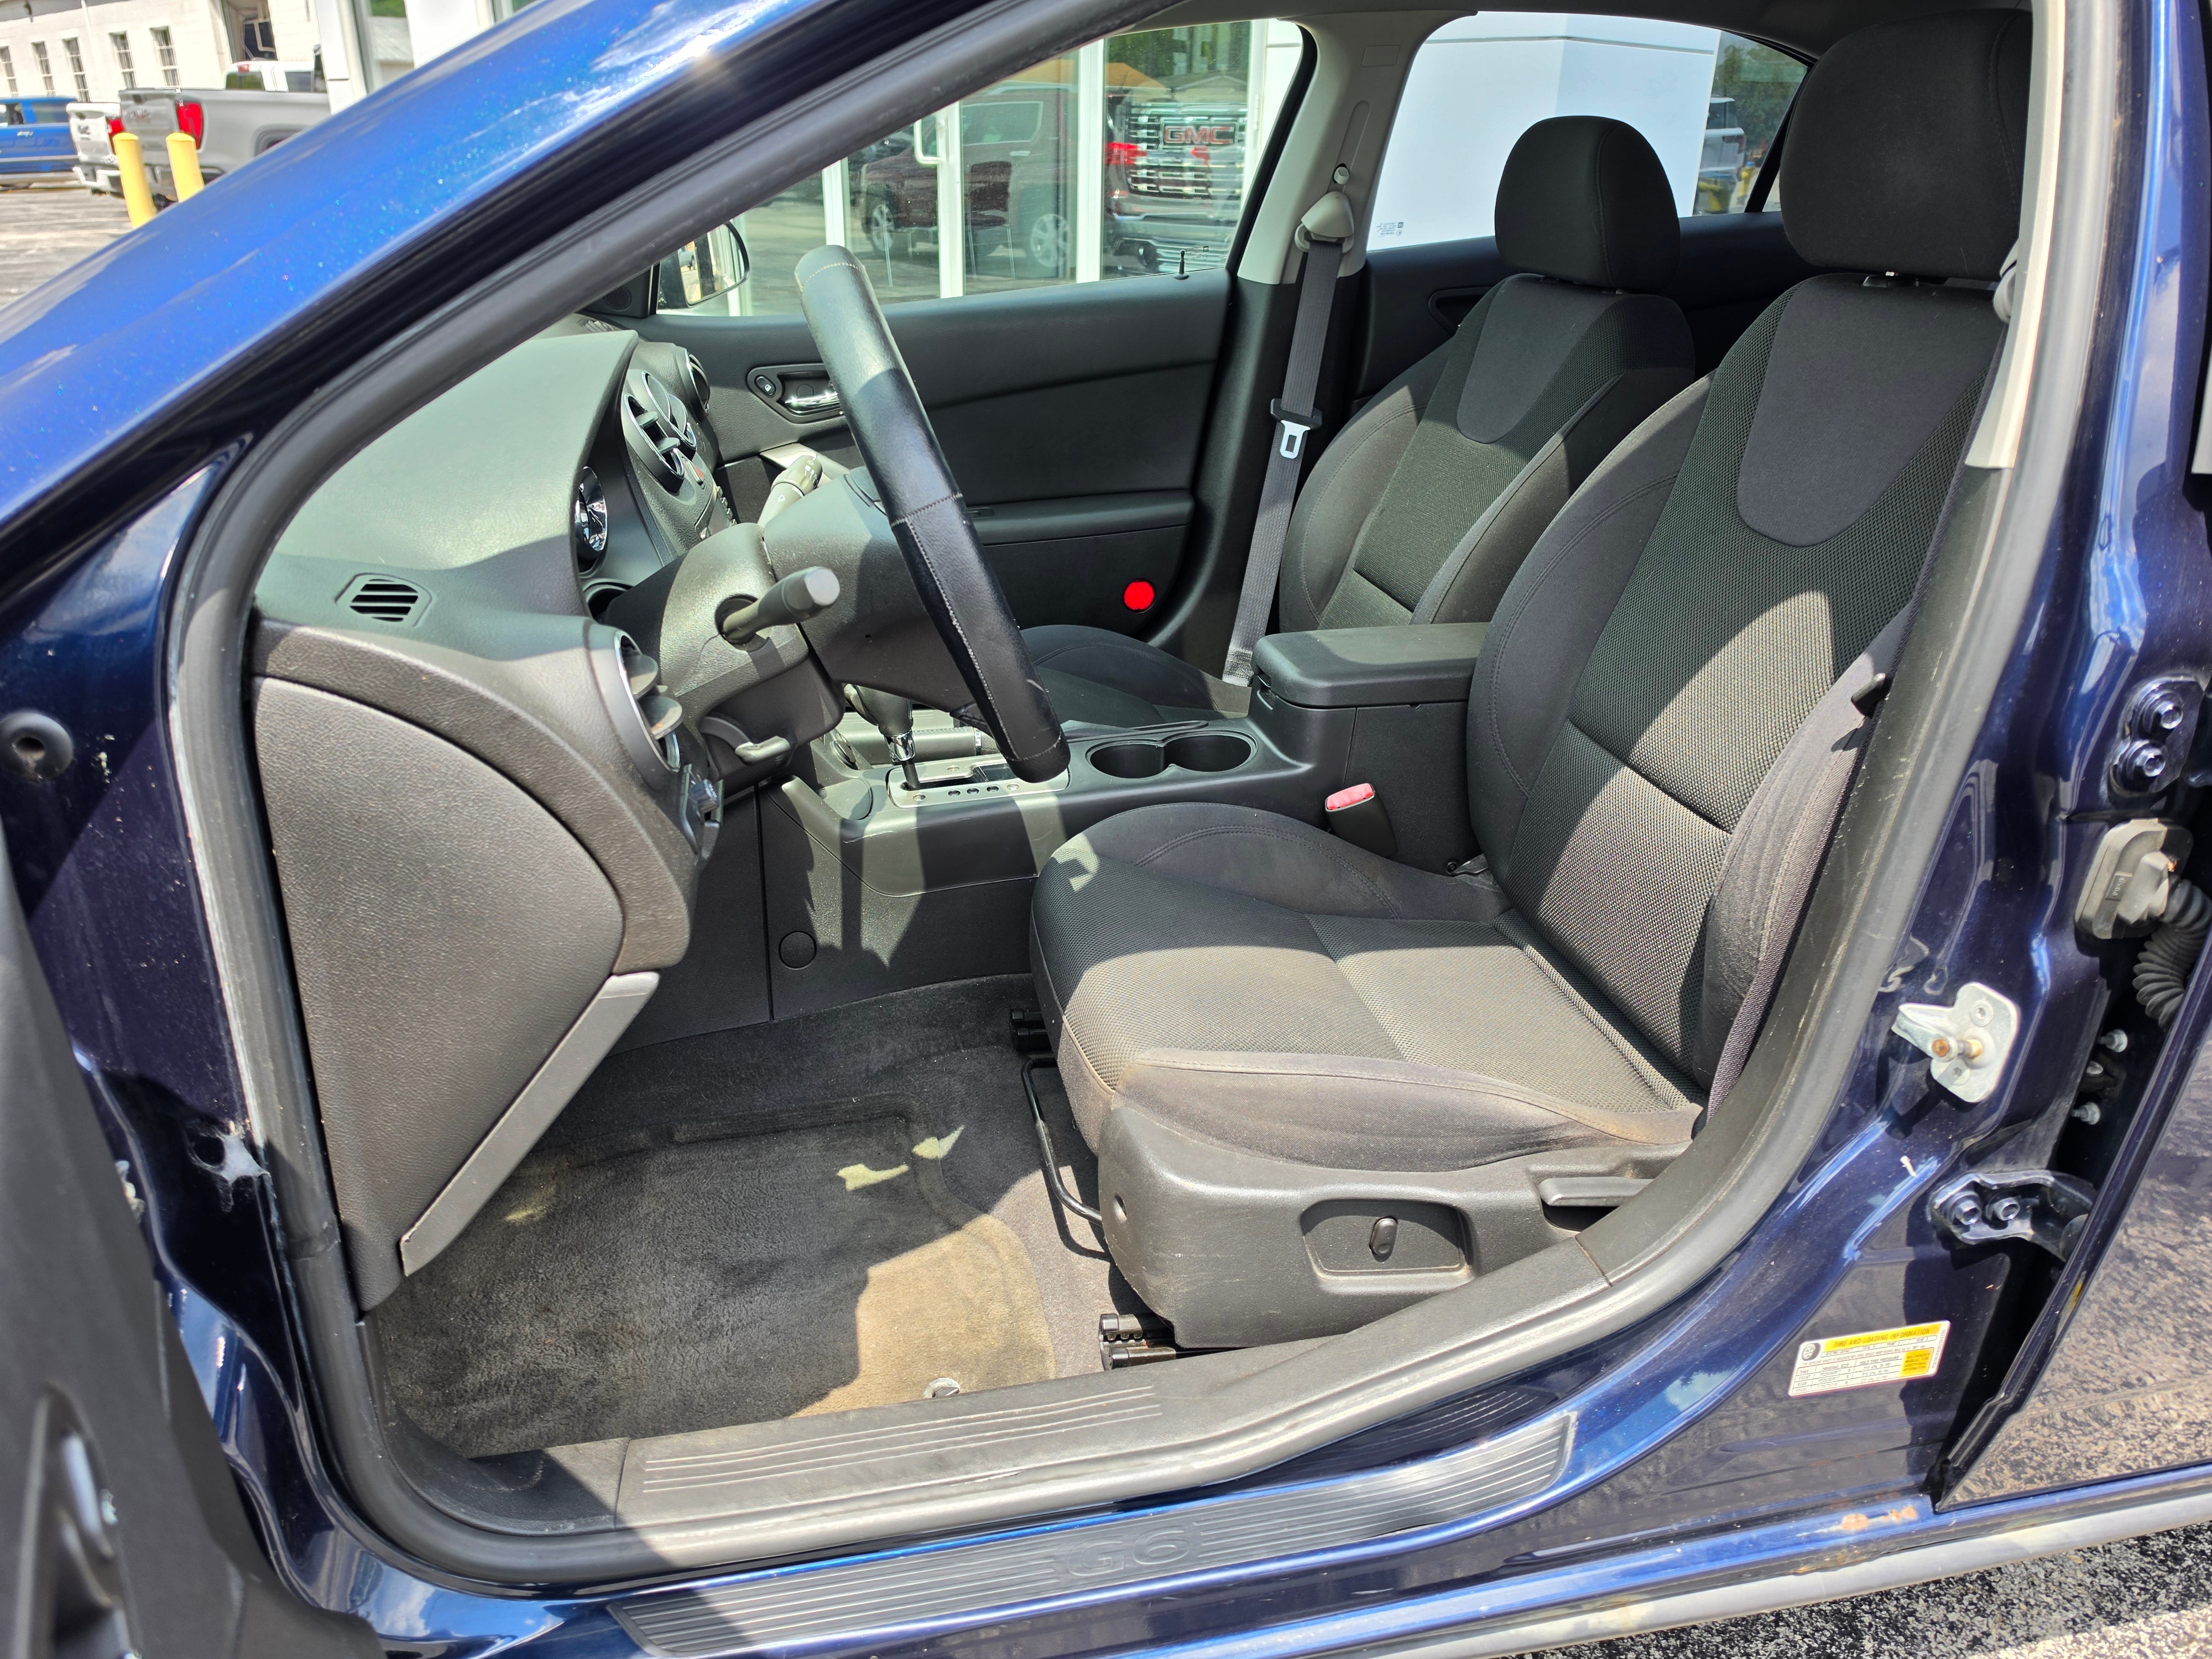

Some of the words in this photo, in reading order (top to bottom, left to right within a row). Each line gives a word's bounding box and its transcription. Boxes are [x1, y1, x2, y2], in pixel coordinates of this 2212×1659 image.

[1164, 126, 1234, 144] GMC
[1863, 1334, 1888, 1343] LOADING
[1890, 1328, 1931, 1339] INFORMATION
[1067, 1525, 1190, 1576] G6
